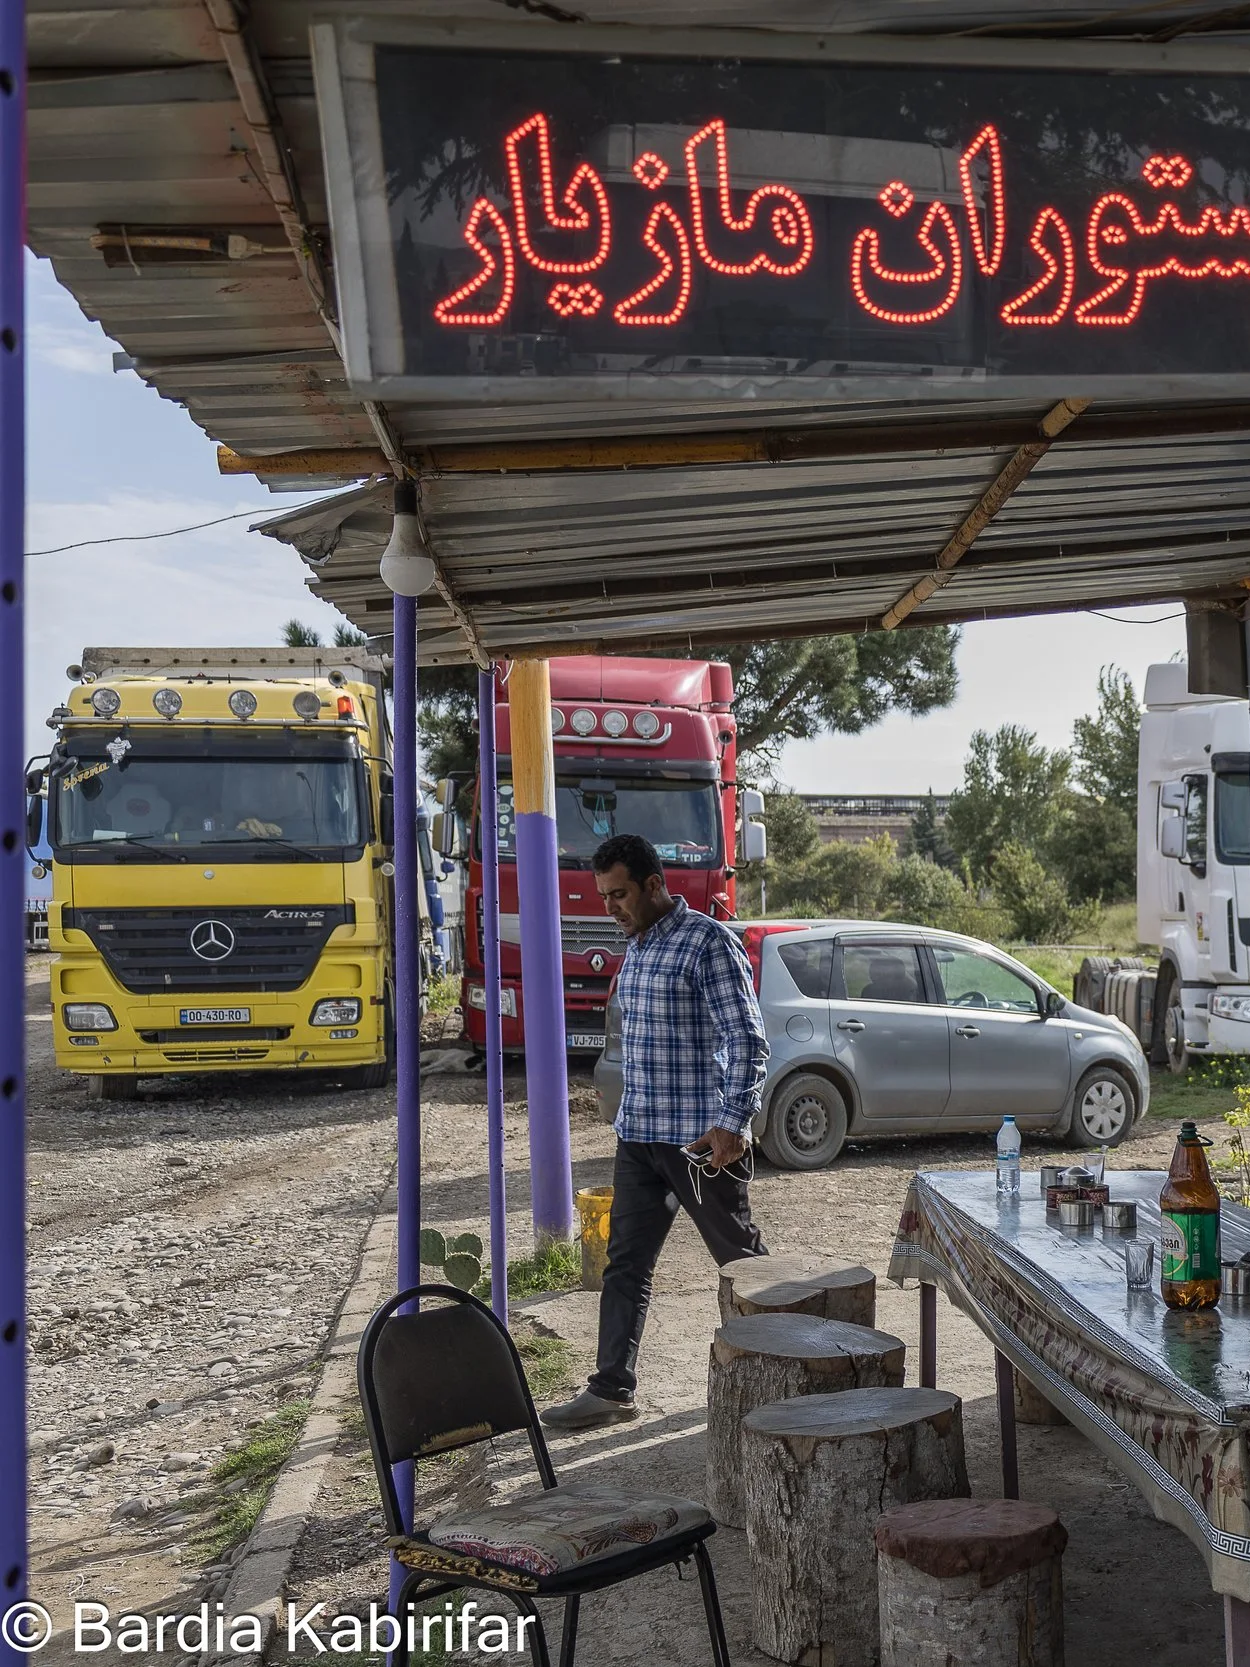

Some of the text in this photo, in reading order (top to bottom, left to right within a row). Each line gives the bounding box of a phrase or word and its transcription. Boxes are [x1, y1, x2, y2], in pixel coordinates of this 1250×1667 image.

[432, 112, 815, 326] مازیار
[63, 762, 110, 792] Sorena
[573, 1035, 605, 1046] VJ-705
